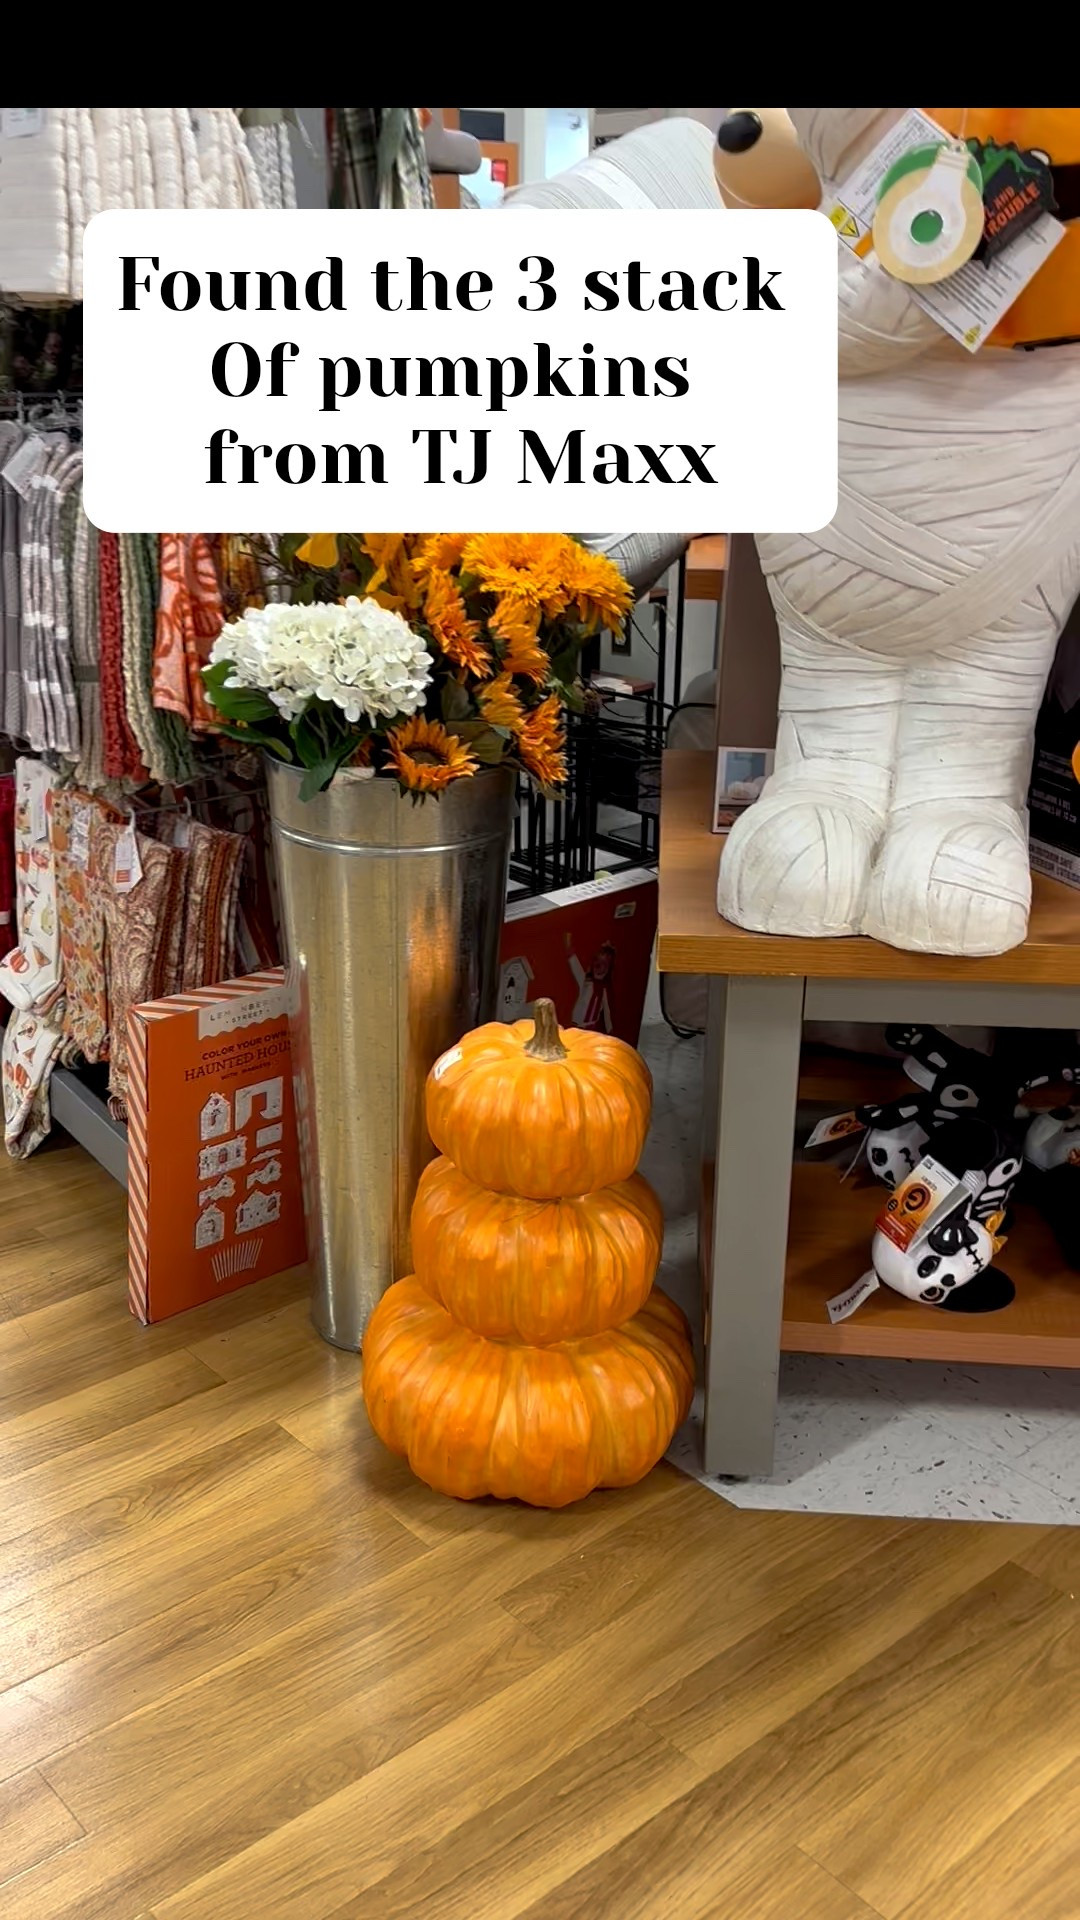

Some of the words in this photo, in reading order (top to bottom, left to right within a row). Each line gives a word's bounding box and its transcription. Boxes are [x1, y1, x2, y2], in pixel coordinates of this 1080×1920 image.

[231, 1009, 263, 1023] STREET
[202, 1045, 235, 1060] COLOR
[236, 1037, 262, 1051] YOUR
[264, 1031, 287, 1042] OWN
[184, 1052, 254, 1081] HAUNTED
